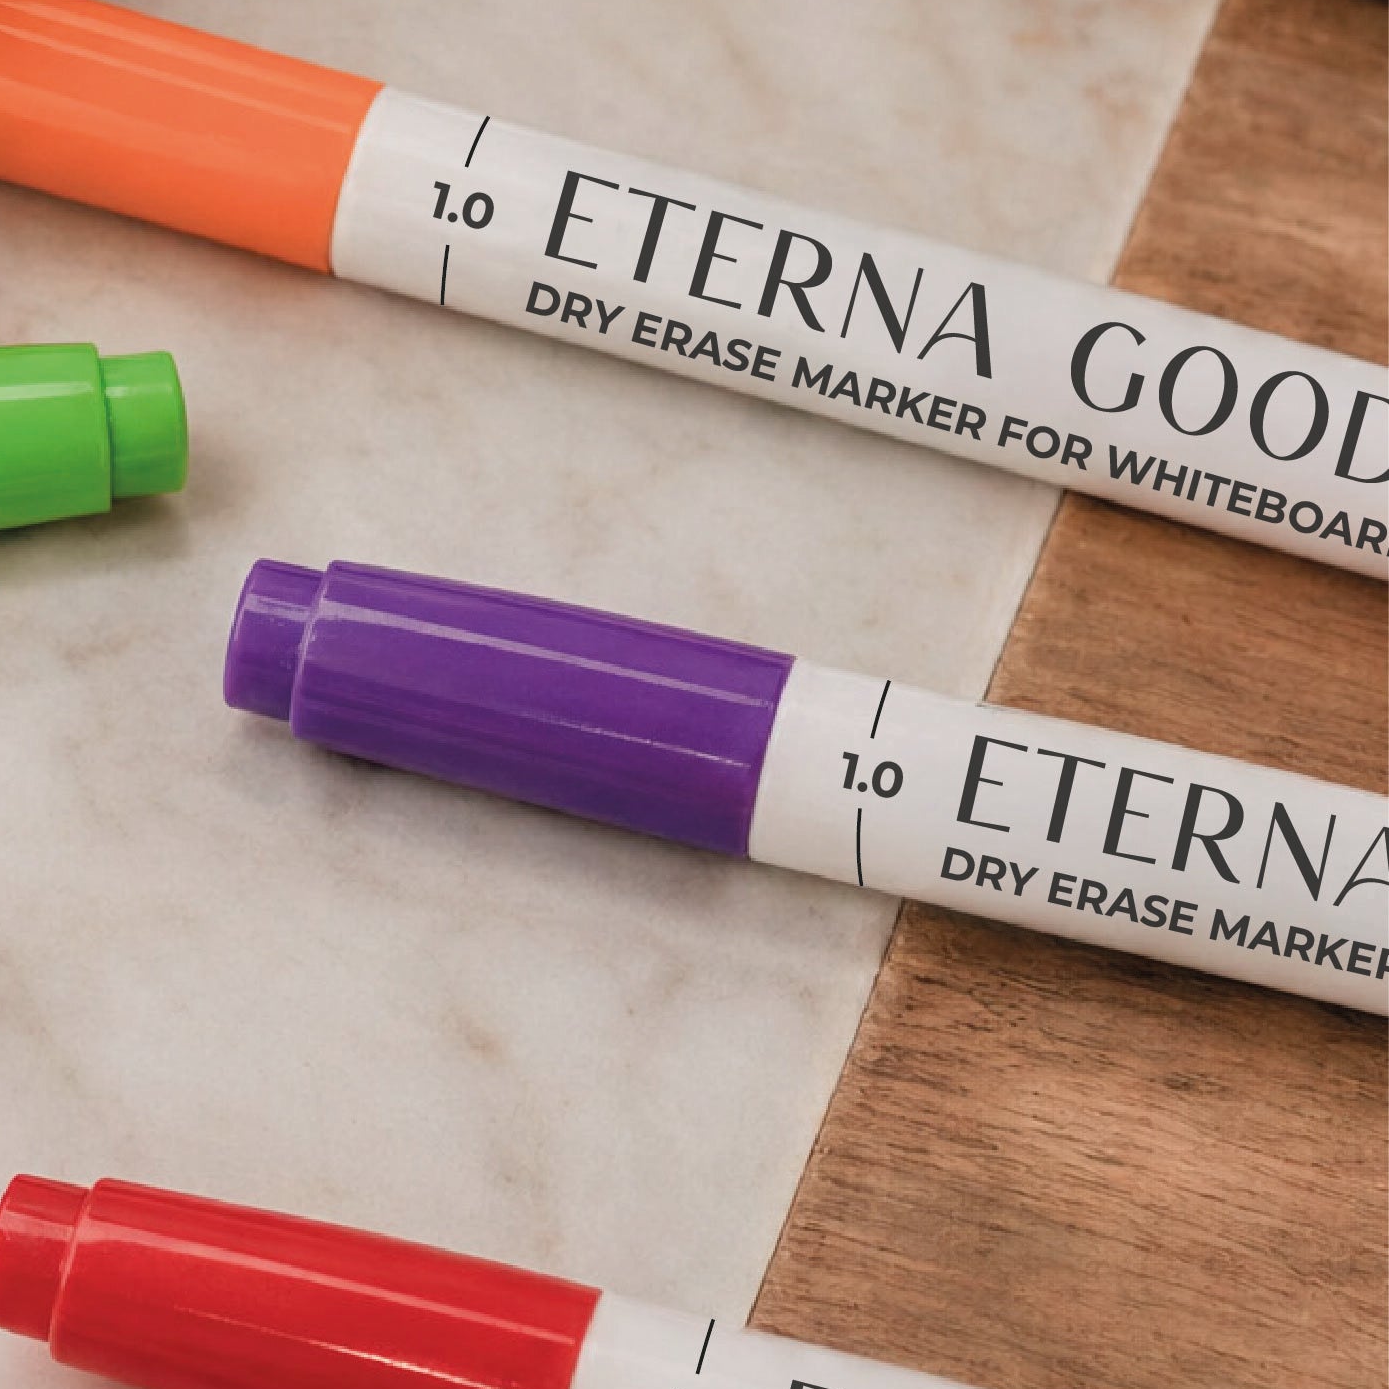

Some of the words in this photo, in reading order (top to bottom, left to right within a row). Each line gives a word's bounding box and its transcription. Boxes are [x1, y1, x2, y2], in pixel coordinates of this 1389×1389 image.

[433, 181, 494, 229] 1.0
[545, 171, 992, 379] ETERNA
[526, 281, 625, 334] DRY
[632, 312, 781, 381] ERASE
[792, 356, 986, 440] MARKER
[998, 416, 1092, 470] FOR
[1109, 445, 1389, 557] WHITEBOAR
[843, 752, 903, 798] 1.0
[941, 847, 1039, 896] DRY
[1048, 872, 1198, 935] ERASE
